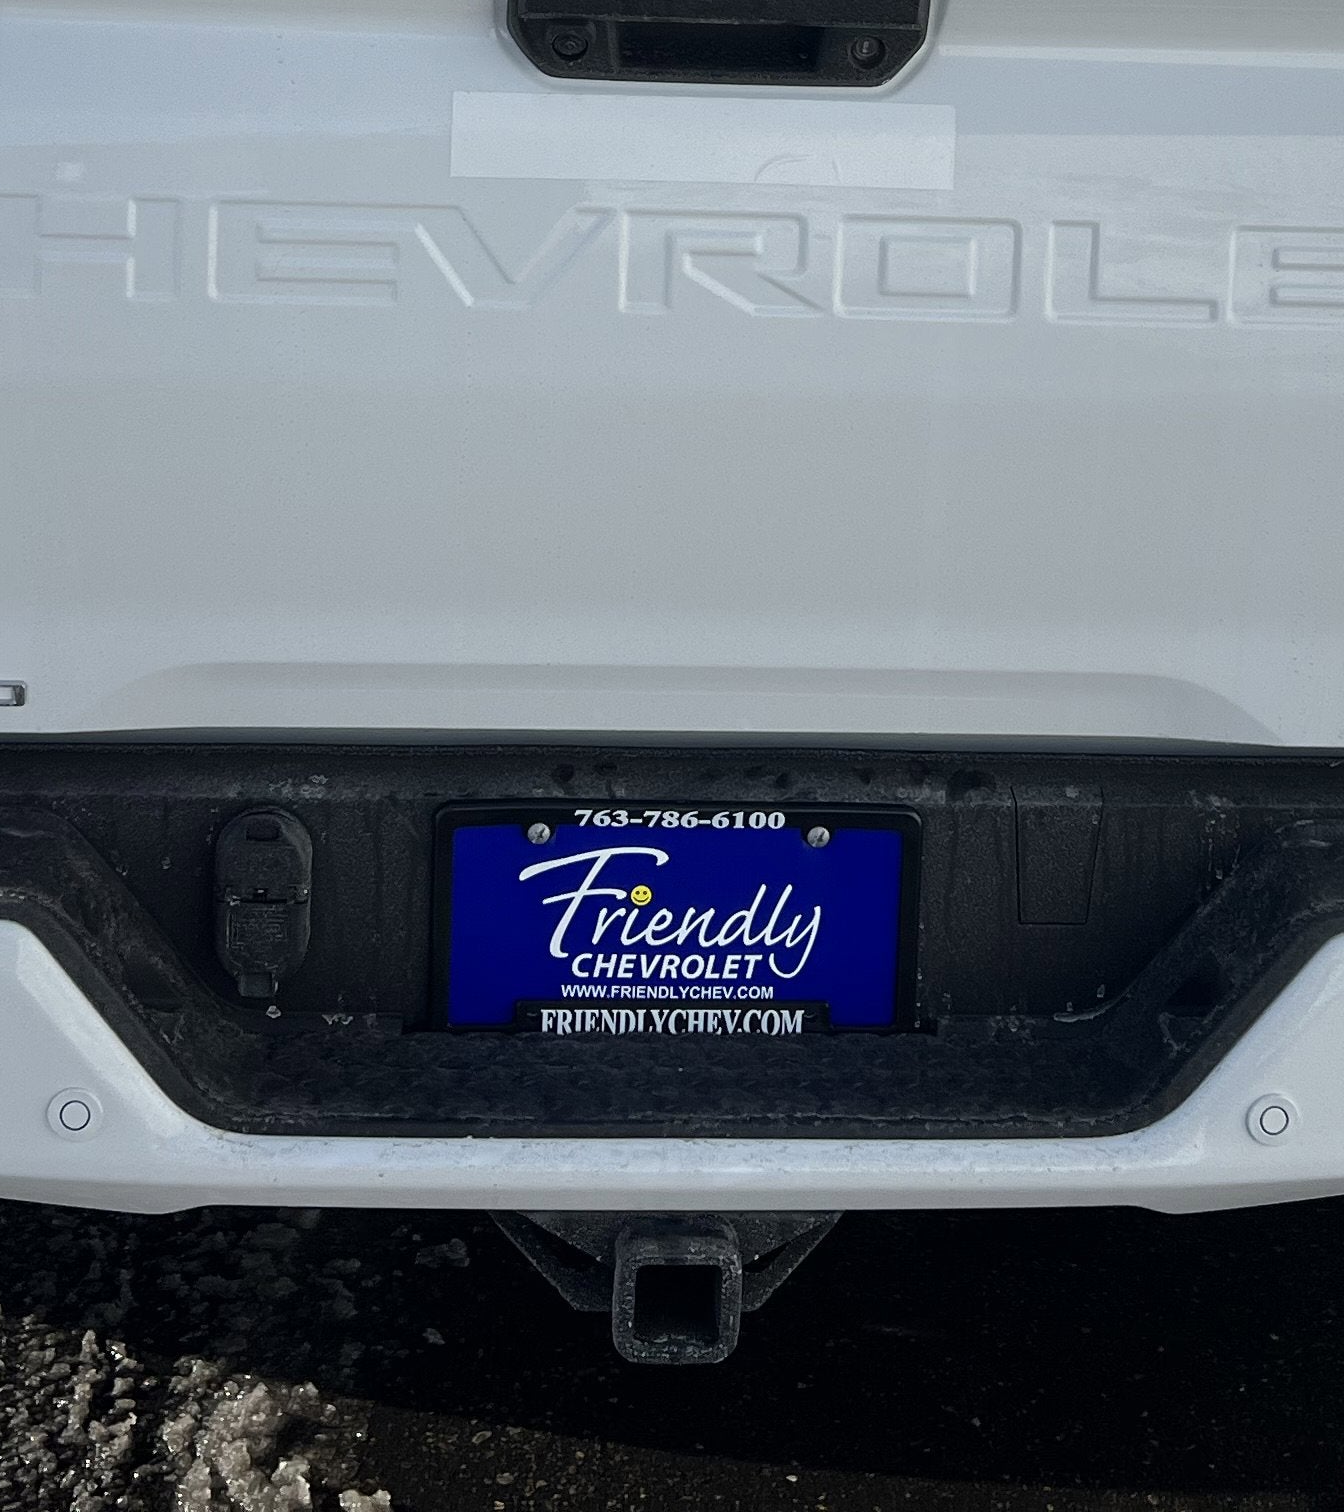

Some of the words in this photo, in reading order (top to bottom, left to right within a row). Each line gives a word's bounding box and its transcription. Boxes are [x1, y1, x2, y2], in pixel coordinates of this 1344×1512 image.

[573, 809, 786, 830] 763-786-6100
[518, 845, 822, 978] Friendly
[571, 953, 764, 980] CHEVROLET
[560, 984, 775, 1000] WWW.FRIENDLYCHEV.COM
[540, 1008, 806, 1037] FRIENDLYCHEV.COM
